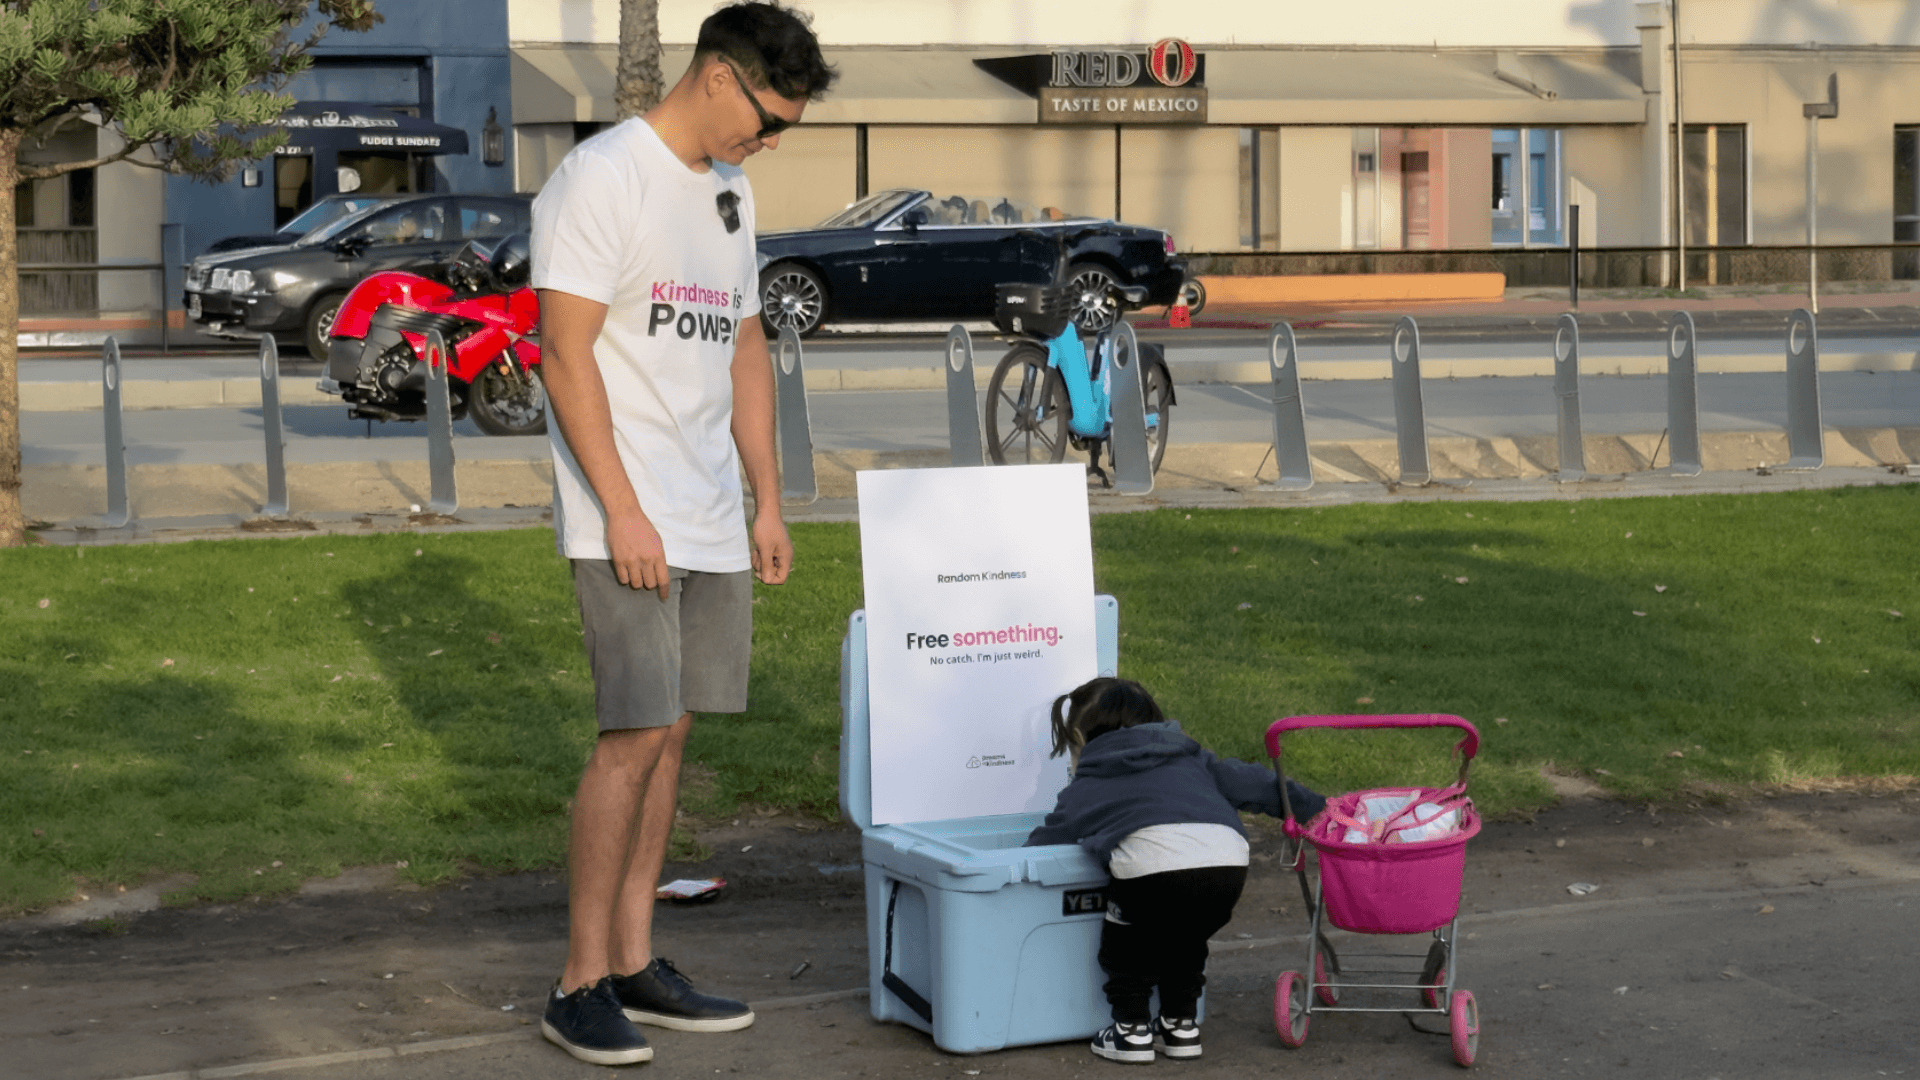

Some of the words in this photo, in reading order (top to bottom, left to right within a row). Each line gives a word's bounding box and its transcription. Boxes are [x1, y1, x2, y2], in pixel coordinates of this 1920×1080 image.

[1049, 51, 1140, 88] RED
[1146, 38, 1197, 88] O
[1052, 98, 1100, 112] TASTE
[1106, 98, 1128, 112] OF
[1133, 98, 1199, 112] MEXICO
[360, 136, 394, 146] FUDGE
[396, 136, 441, 147] SUNDAES
[651, 279, 729, 307] Kindness
[732, 286, 742, 309] is
[937, 572, 980, 584] Random
[981, 570, 1027, 582] Kindness
[906, 632, 949, 650] Free
[953, 622, 1063, 647] something.
[930, 656, 944, 665] No
[993, 651, 1012, 663] just
[1066, 892, 1104, 911] YET
